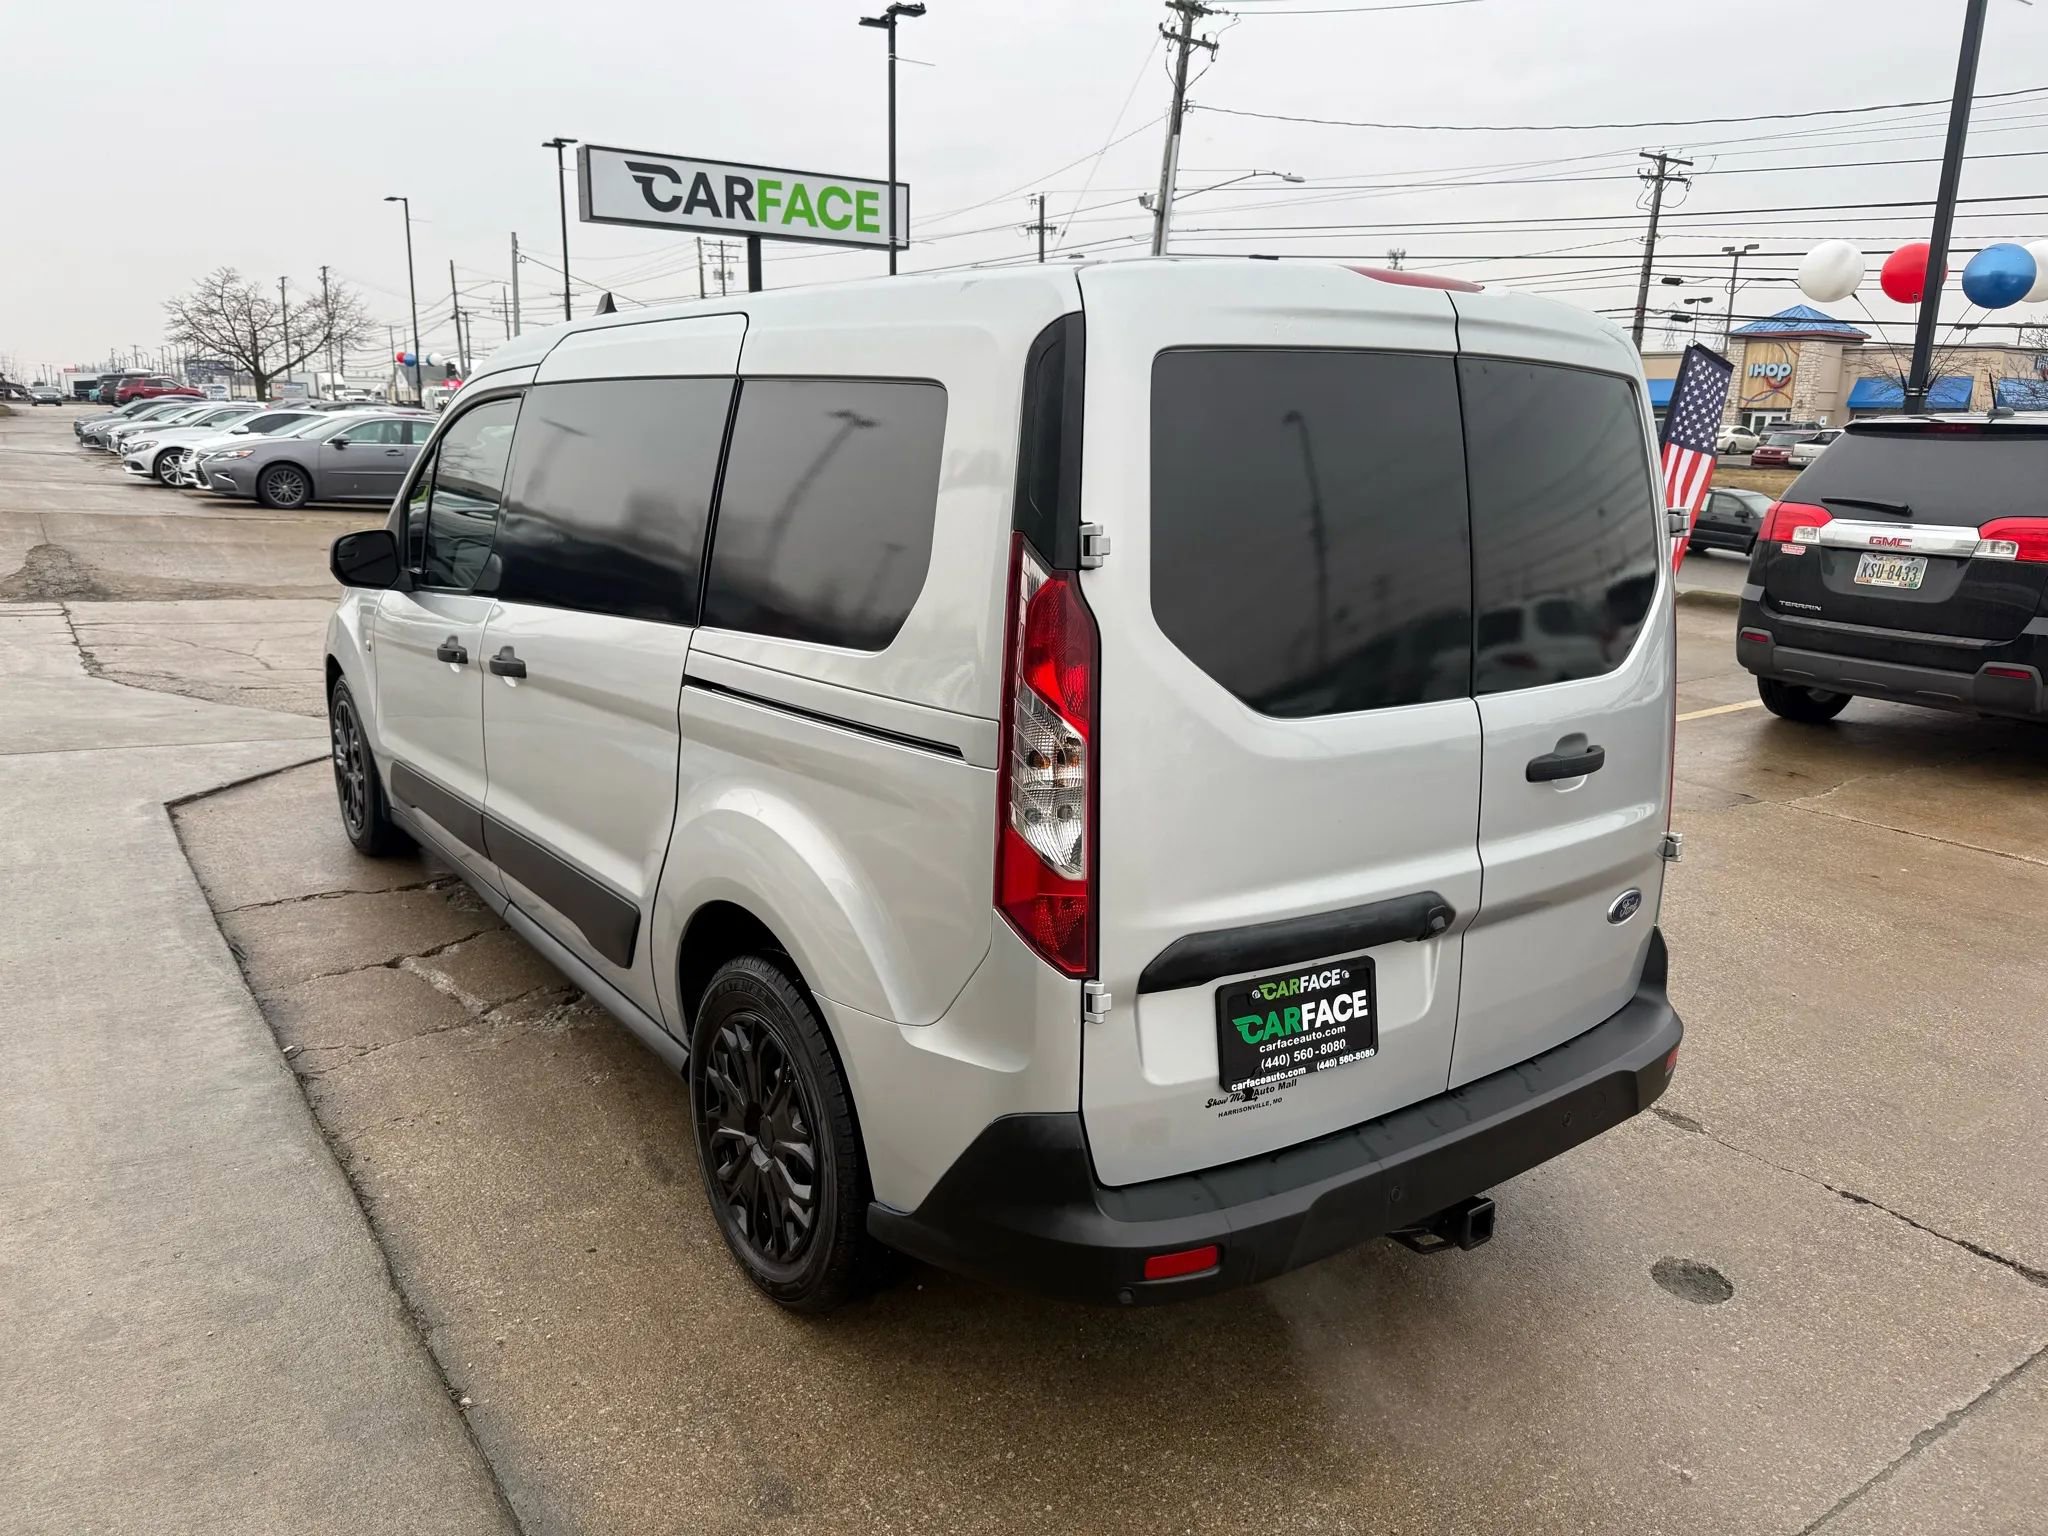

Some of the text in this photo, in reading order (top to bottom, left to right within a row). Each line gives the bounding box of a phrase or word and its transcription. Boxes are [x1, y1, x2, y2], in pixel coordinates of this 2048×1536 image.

[624, 160, 880, 234] CARFACE
[1869, 536, 1912, 549] GMC
[1861, 562, 1919, 582] KSU-8433
[1779, 600, 1821, 611] TERRAIN
[1619, 897, 1639, 918] Ford
[1259, 968, 1341, 1001] CARFACE
[1232, 990, 1369, 1045] CARFACE
[1259, 1025, 1346, 1053] carfaceauto.com
[1231, 1048, 1375, 1092] carfaceauto.com (440) 560-8080
[1261, 1052, 1291, 1072] (440)
[1205, 1079, 1297, 1109] Show Me Auto Mall
[1218, 1097, 1283, 1118] HARRISONVILLE, MO
